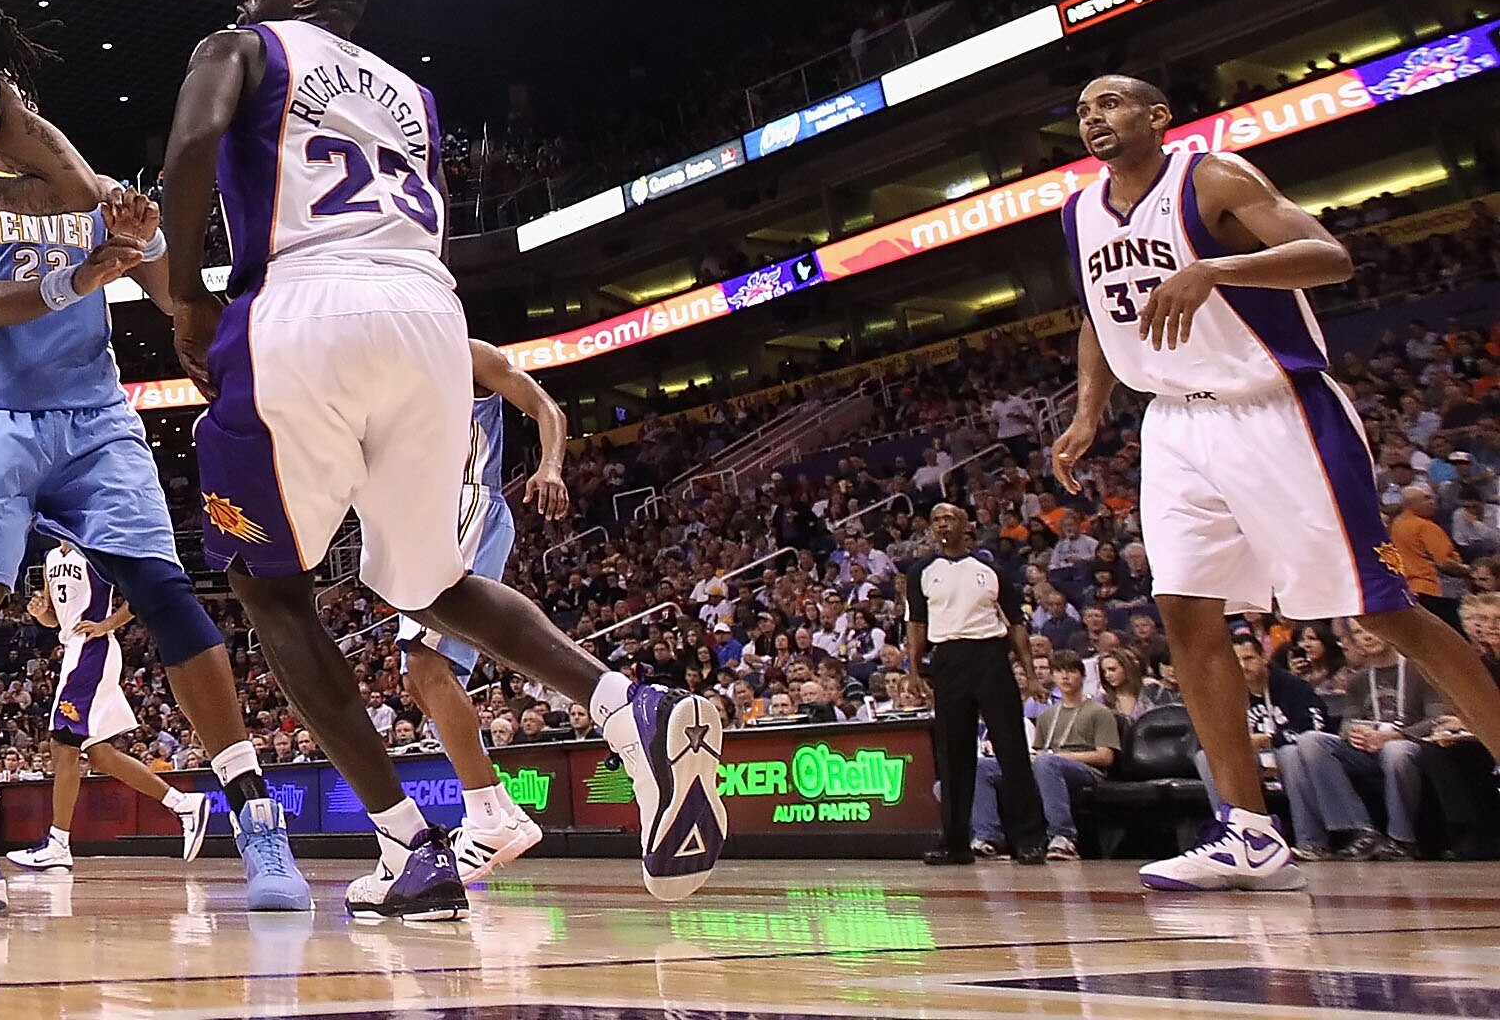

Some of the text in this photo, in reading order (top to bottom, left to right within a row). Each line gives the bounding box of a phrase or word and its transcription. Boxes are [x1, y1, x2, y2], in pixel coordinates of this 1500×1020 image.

[288, 64, 427, 162] RICHARDSON
[305, 135, 440, 236] 23
[1088, 237, 1178, 285] SUNS
[57, 584, 67, 604] 3
[773, 801, 872, 823] AUTO PARTS
